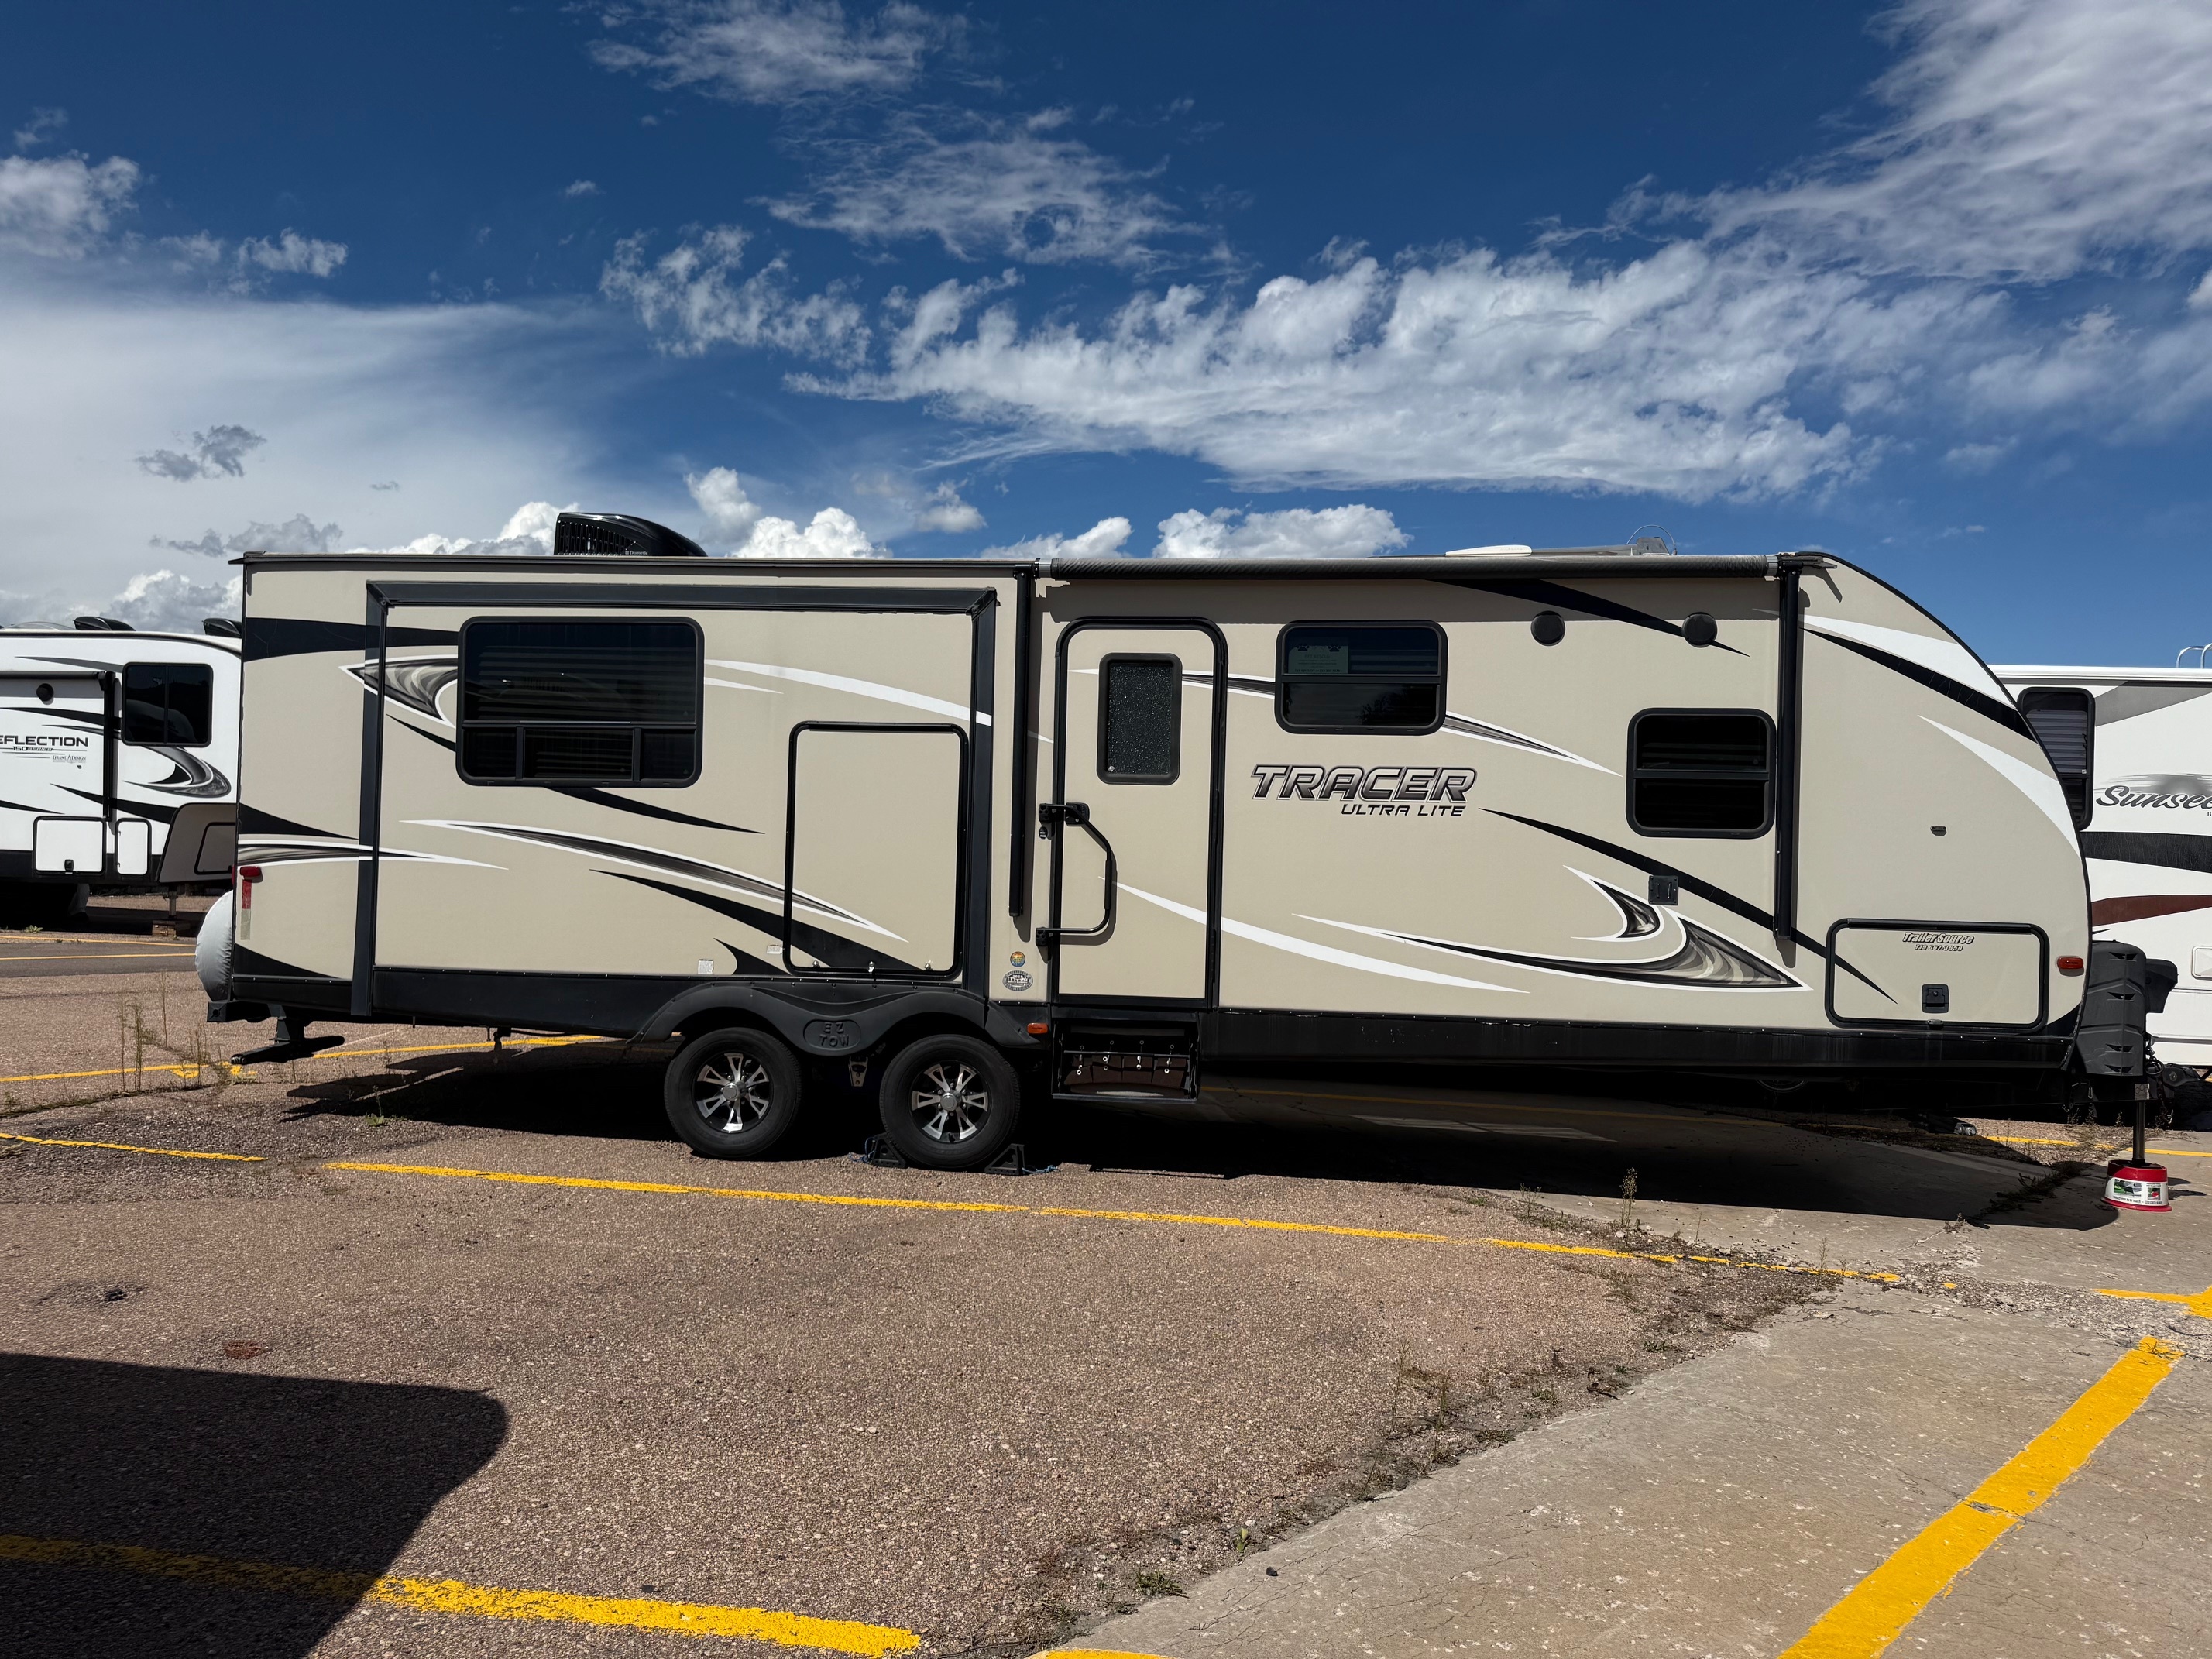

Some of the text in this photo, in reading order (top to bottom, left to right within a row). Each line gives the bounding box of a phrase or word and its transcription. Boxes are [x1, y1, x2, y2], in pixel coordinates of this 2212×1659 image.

[1251, 764, 1478, 802] TRACER
[1341, 804, 1466, 817] ULTRA LITE
[1902, 932, 1975, 945] Trailer Source
[819, 1034, 850, 1047] TOW
